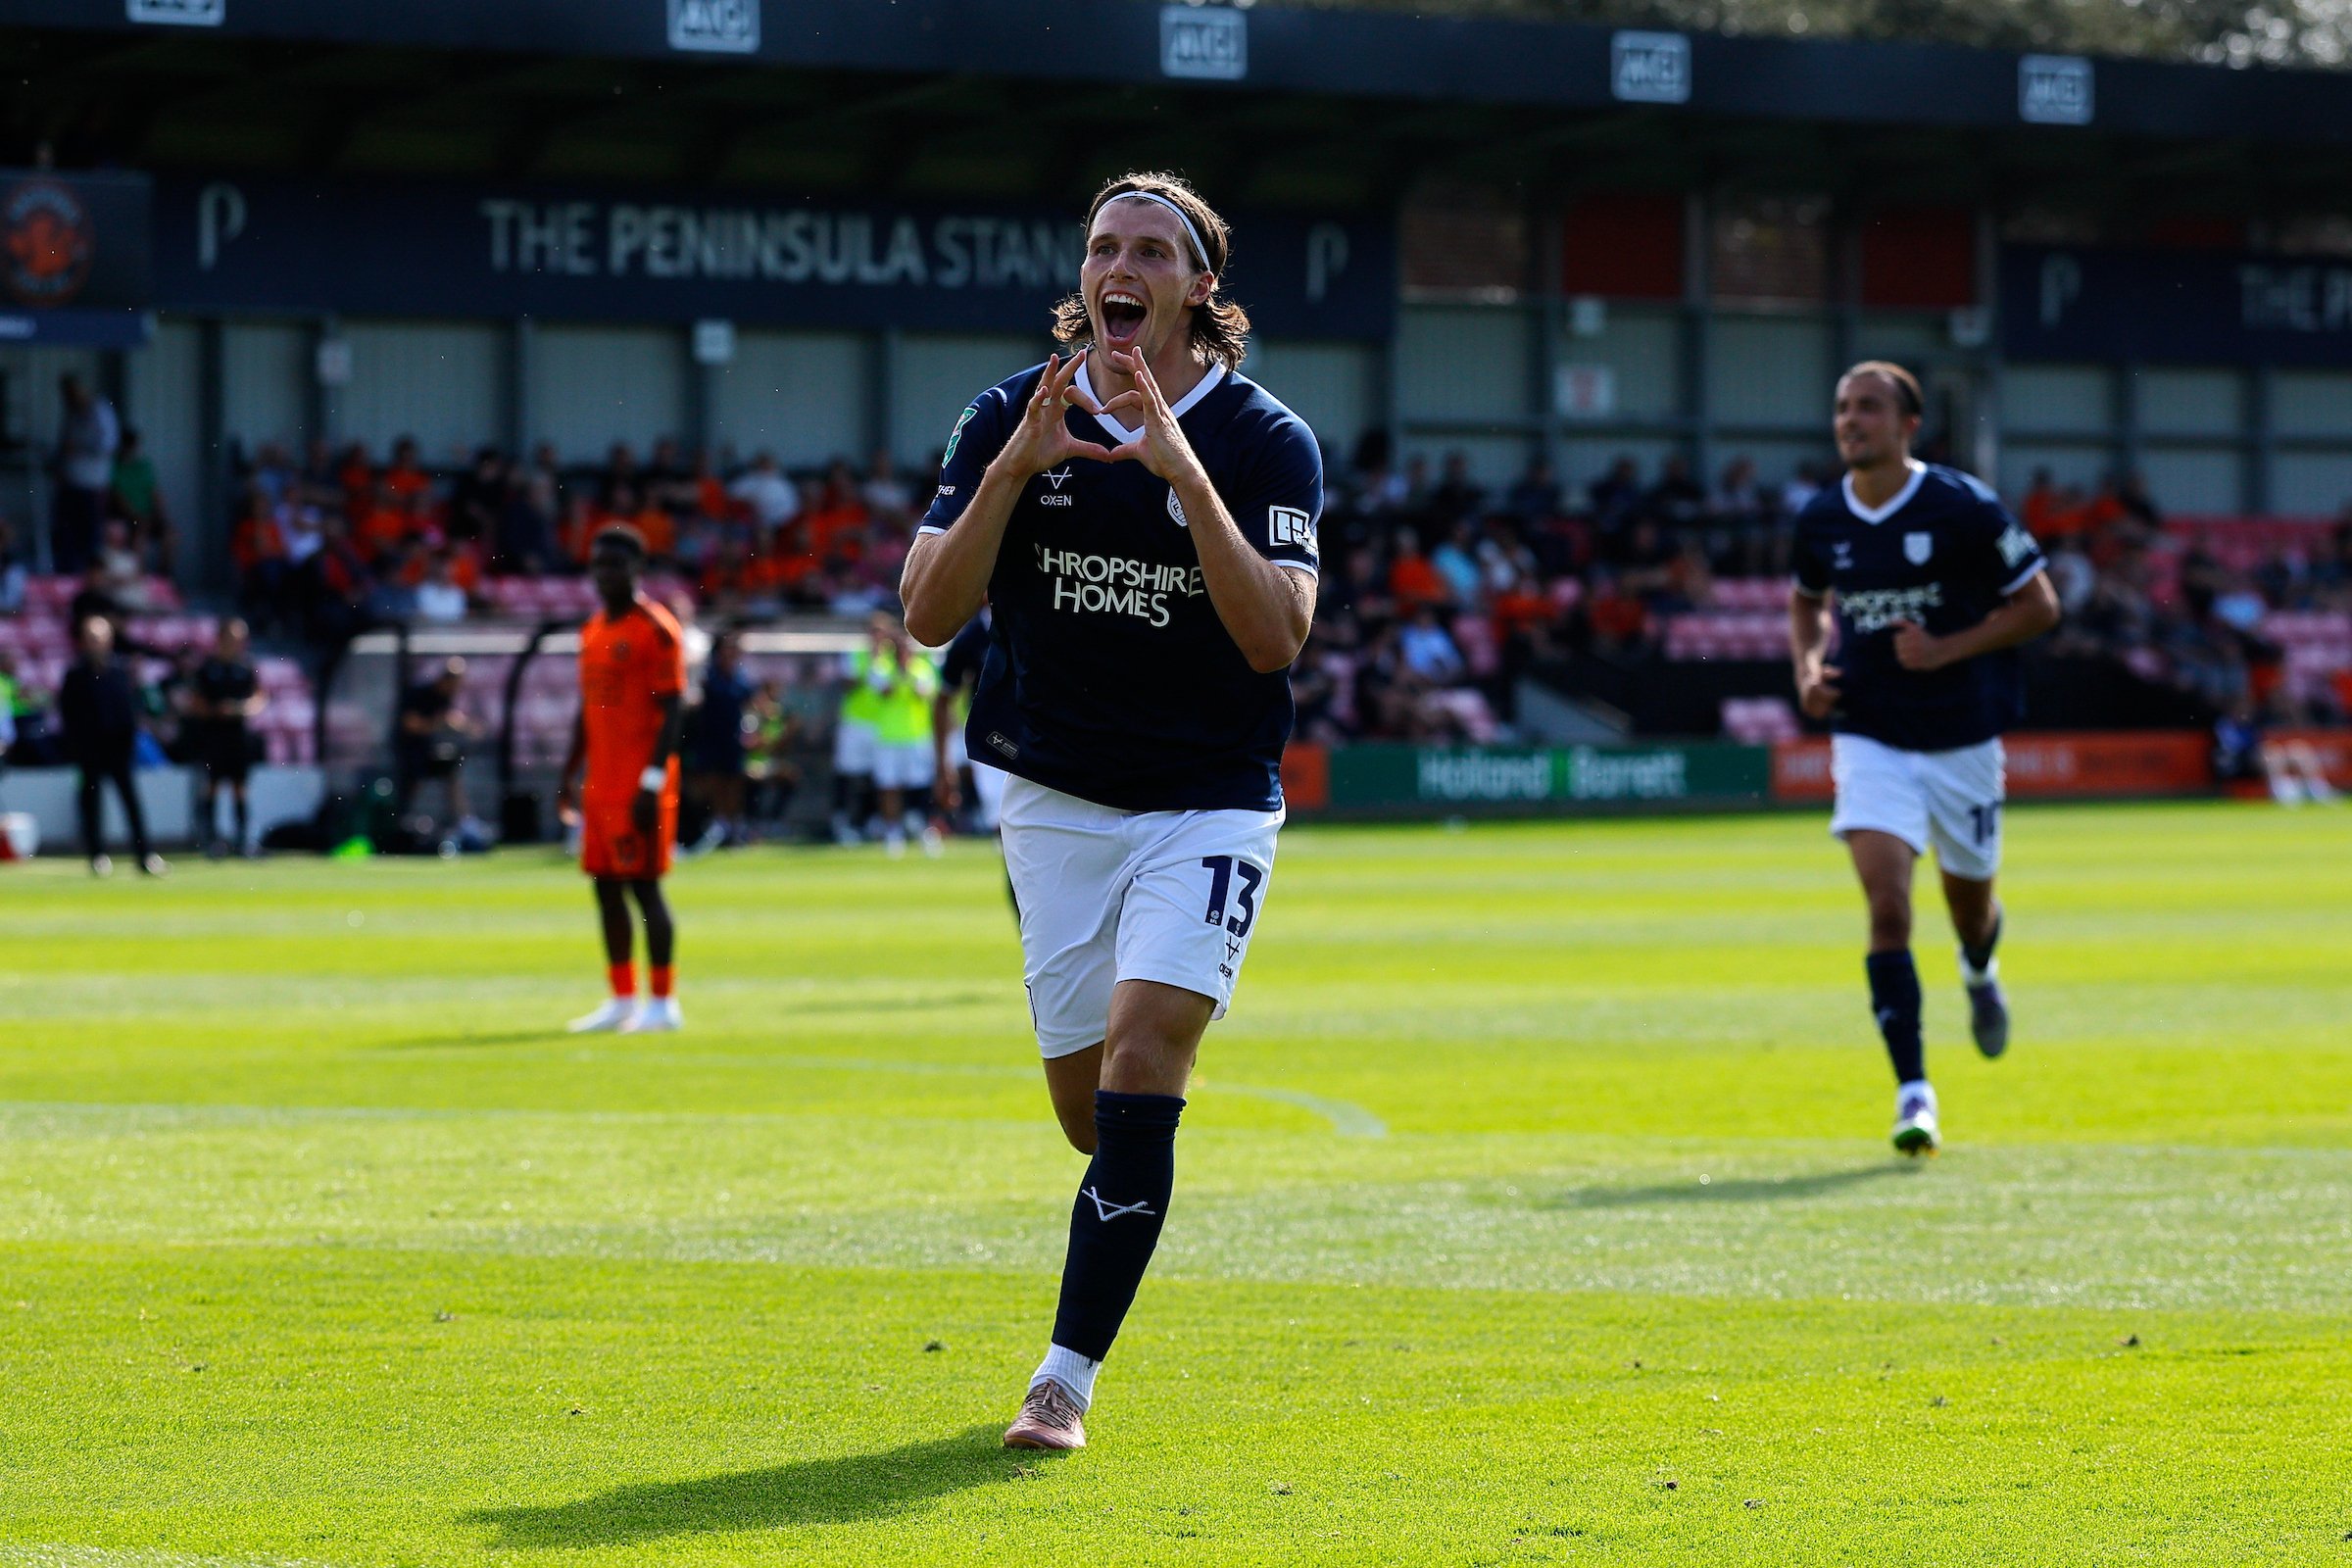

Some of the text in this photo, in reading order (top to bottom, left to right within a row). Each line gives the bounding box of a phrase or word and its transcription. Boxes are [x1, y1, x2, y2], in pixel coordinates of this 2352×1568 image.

[478, 201, 1083, 287] THE PENINSULA STAN
[1041, 495, 1071, 506] OXEN
[1054, 576, 1170, 628] HOMES
[1201, 856, 1262, 938] 13
